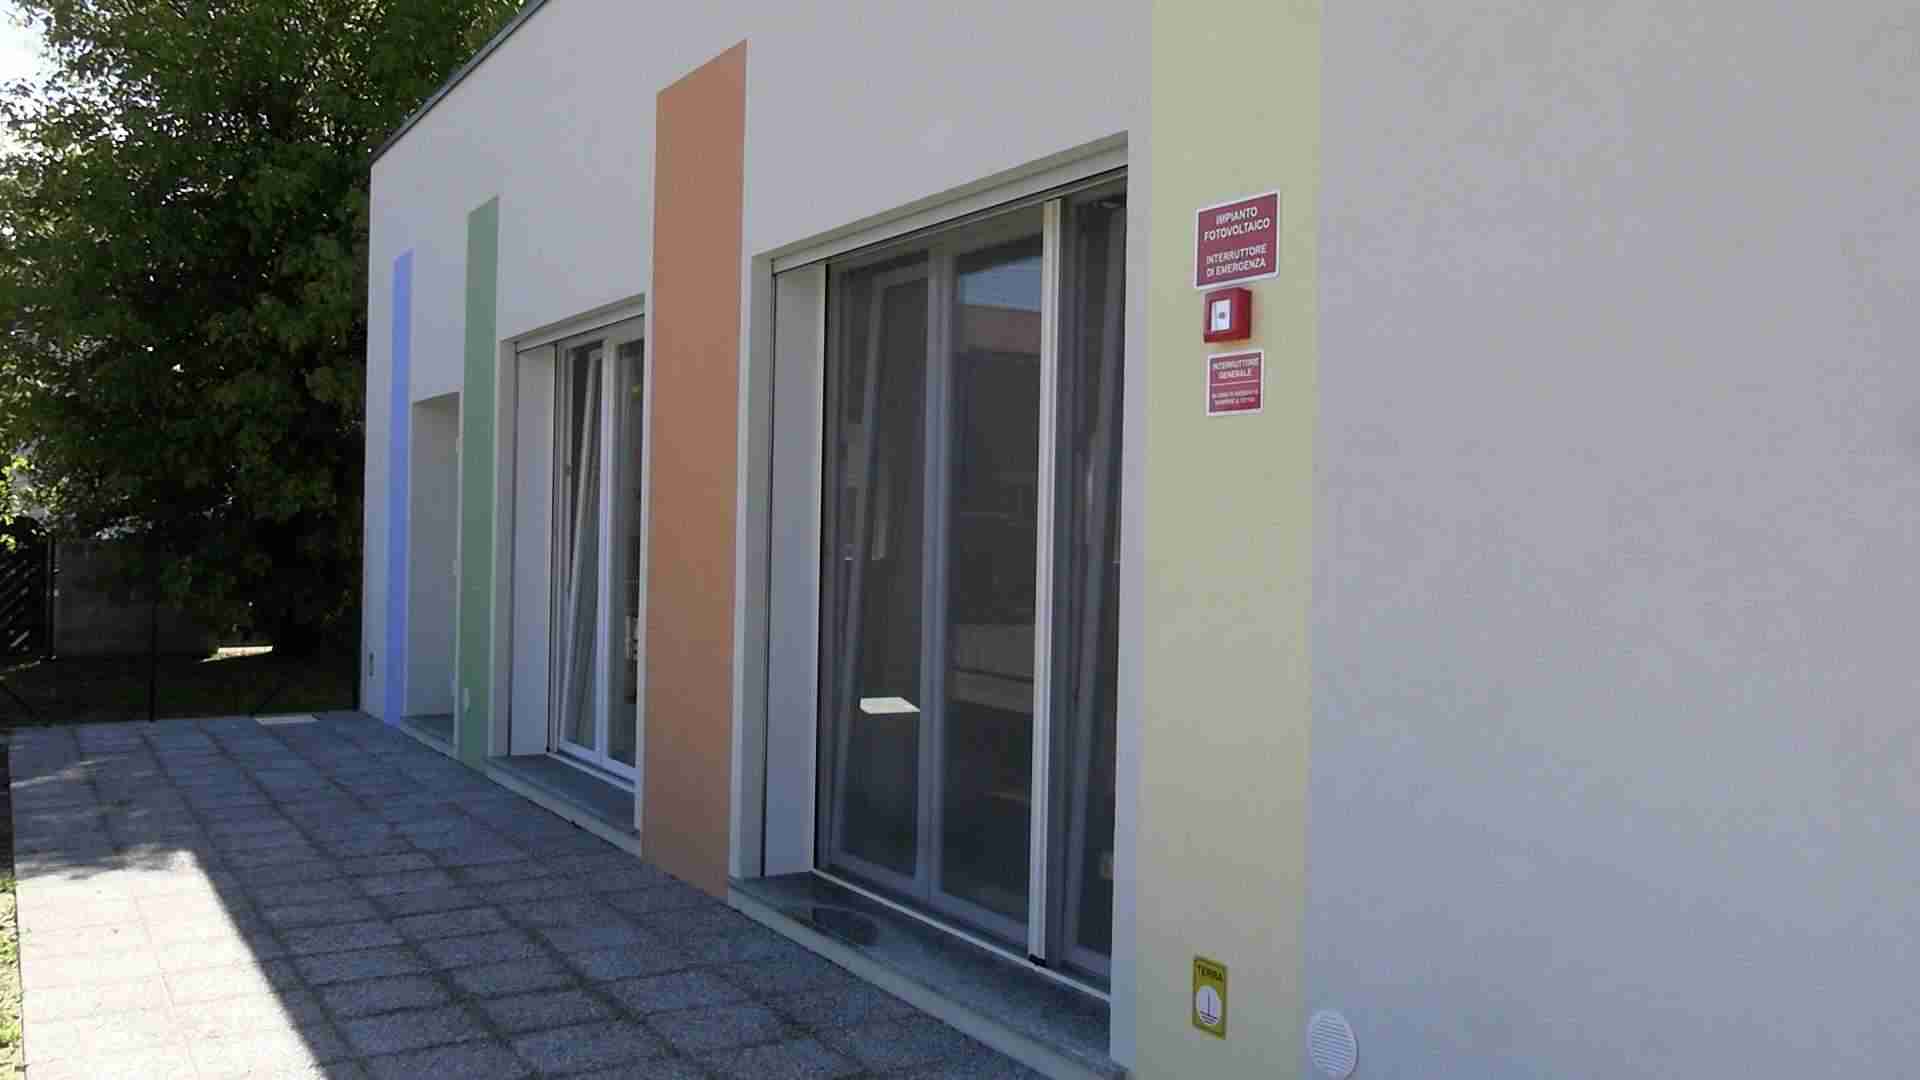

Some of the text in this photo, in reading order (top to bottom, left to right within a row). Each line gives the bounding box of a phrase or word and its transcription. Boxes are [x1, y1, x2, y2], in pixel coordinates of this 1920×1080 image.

[1215, 207, 1257, 225] IMPIANTO
[1204, 217, 1270, 241] FOTOVOLTAICO
[1206, 243, 1267, 265] INTERRUTTORE
[1216, 258, 1266, 275] EMERGENZA
